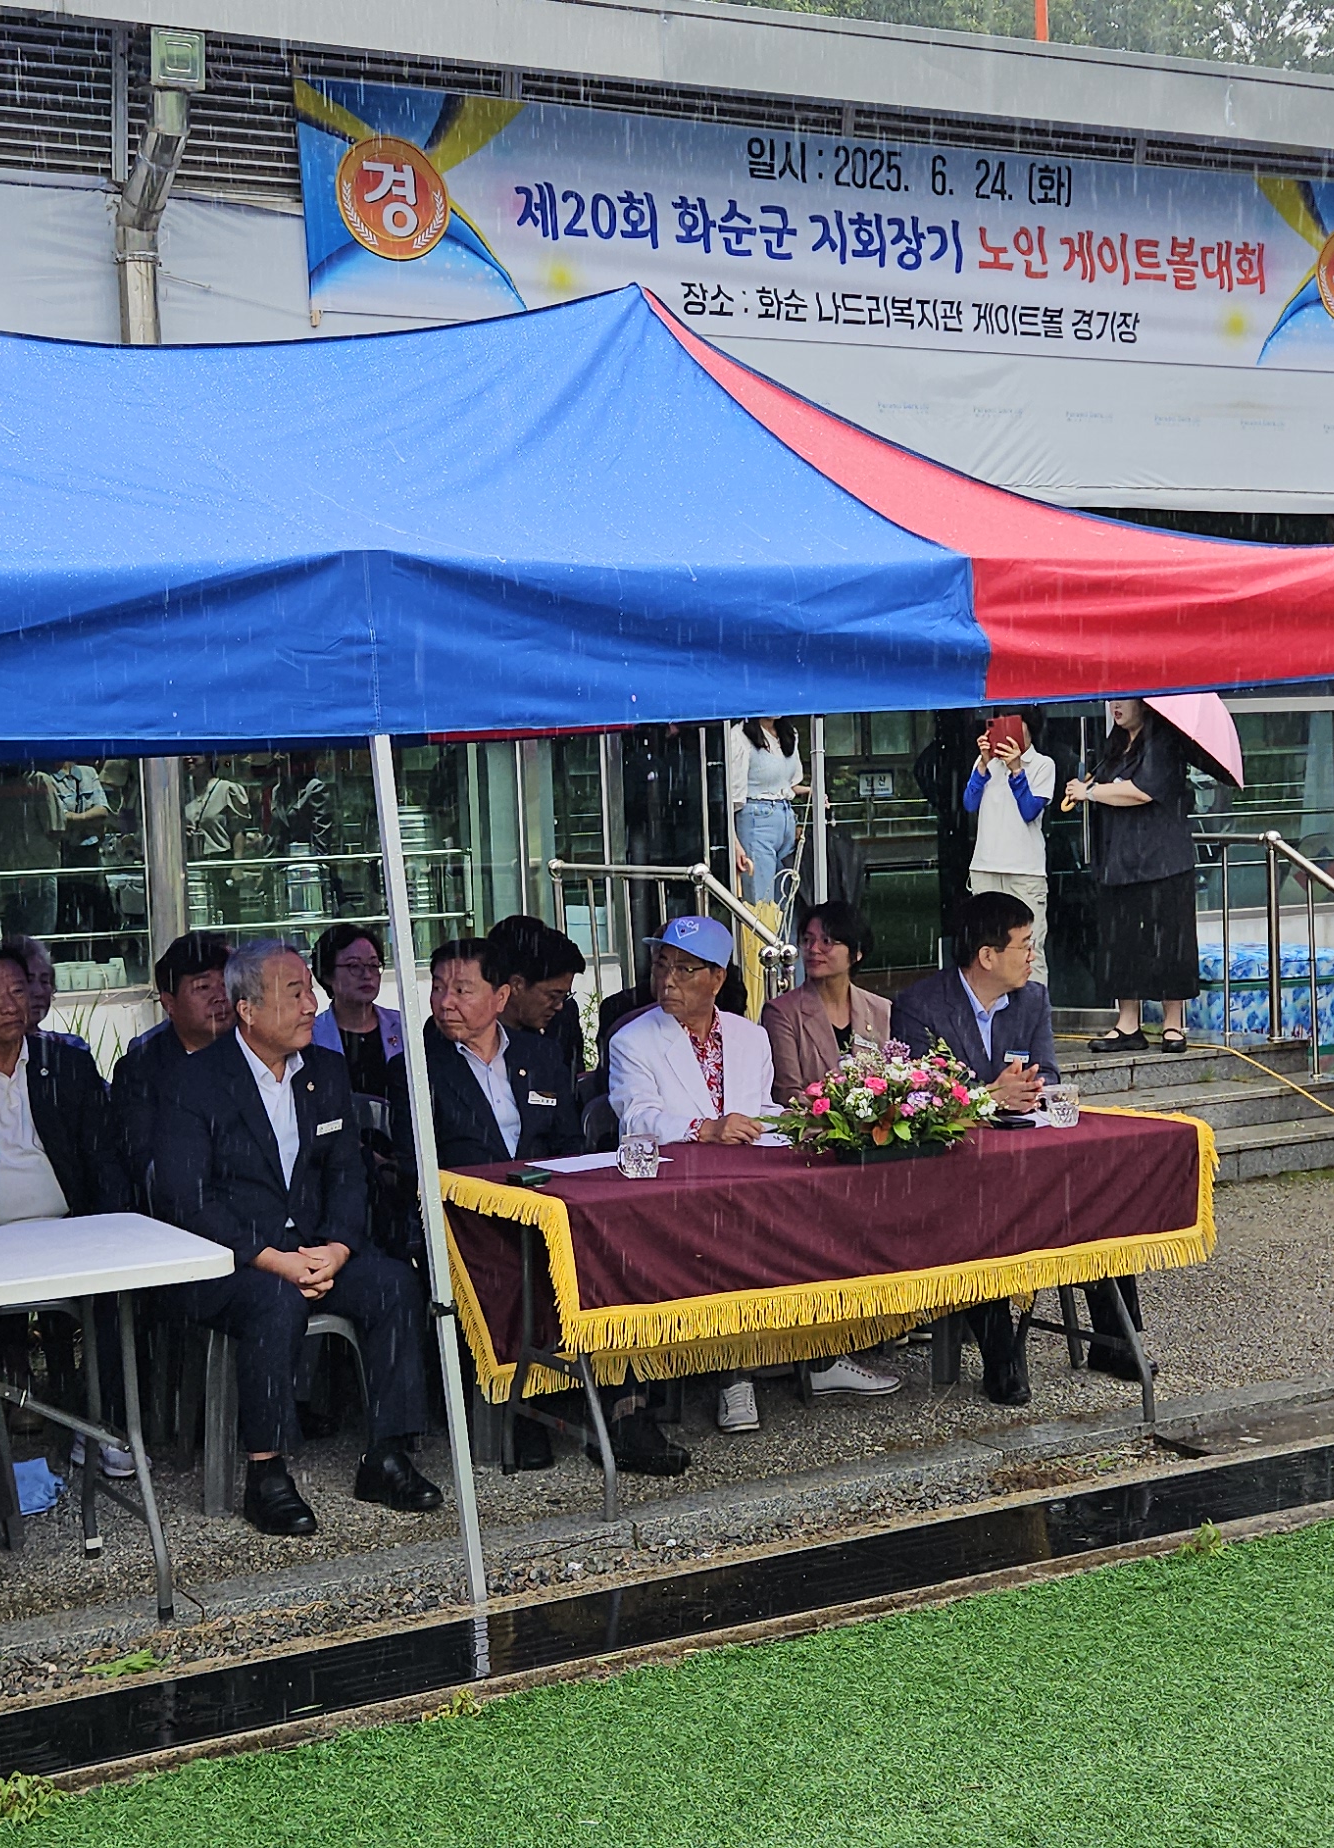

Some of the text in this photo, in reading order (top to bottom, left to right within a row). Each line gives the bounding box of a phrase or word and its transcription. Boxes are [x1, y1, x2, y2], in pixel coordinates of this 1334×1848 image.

[362, 161, 419, 238] 경
[747, 137, 806, 183] 일시
[833, 146, 909, 192] 2025.
[931, 153, 954, 196] 6.
[975, 158, 1013, 201] 24.
[515, 182, 1266, 295] 제20회 화순군 지회장기 노인 게이트볼대회
[680, 282, 734, 317] 장소
[756, 286, 808, 323] 화순
[816, 291, 963, 333] 나드리복지관
[971, 302, 1064, 339] 게이트볼
[1071, 309, 1140, 344] 경기장
